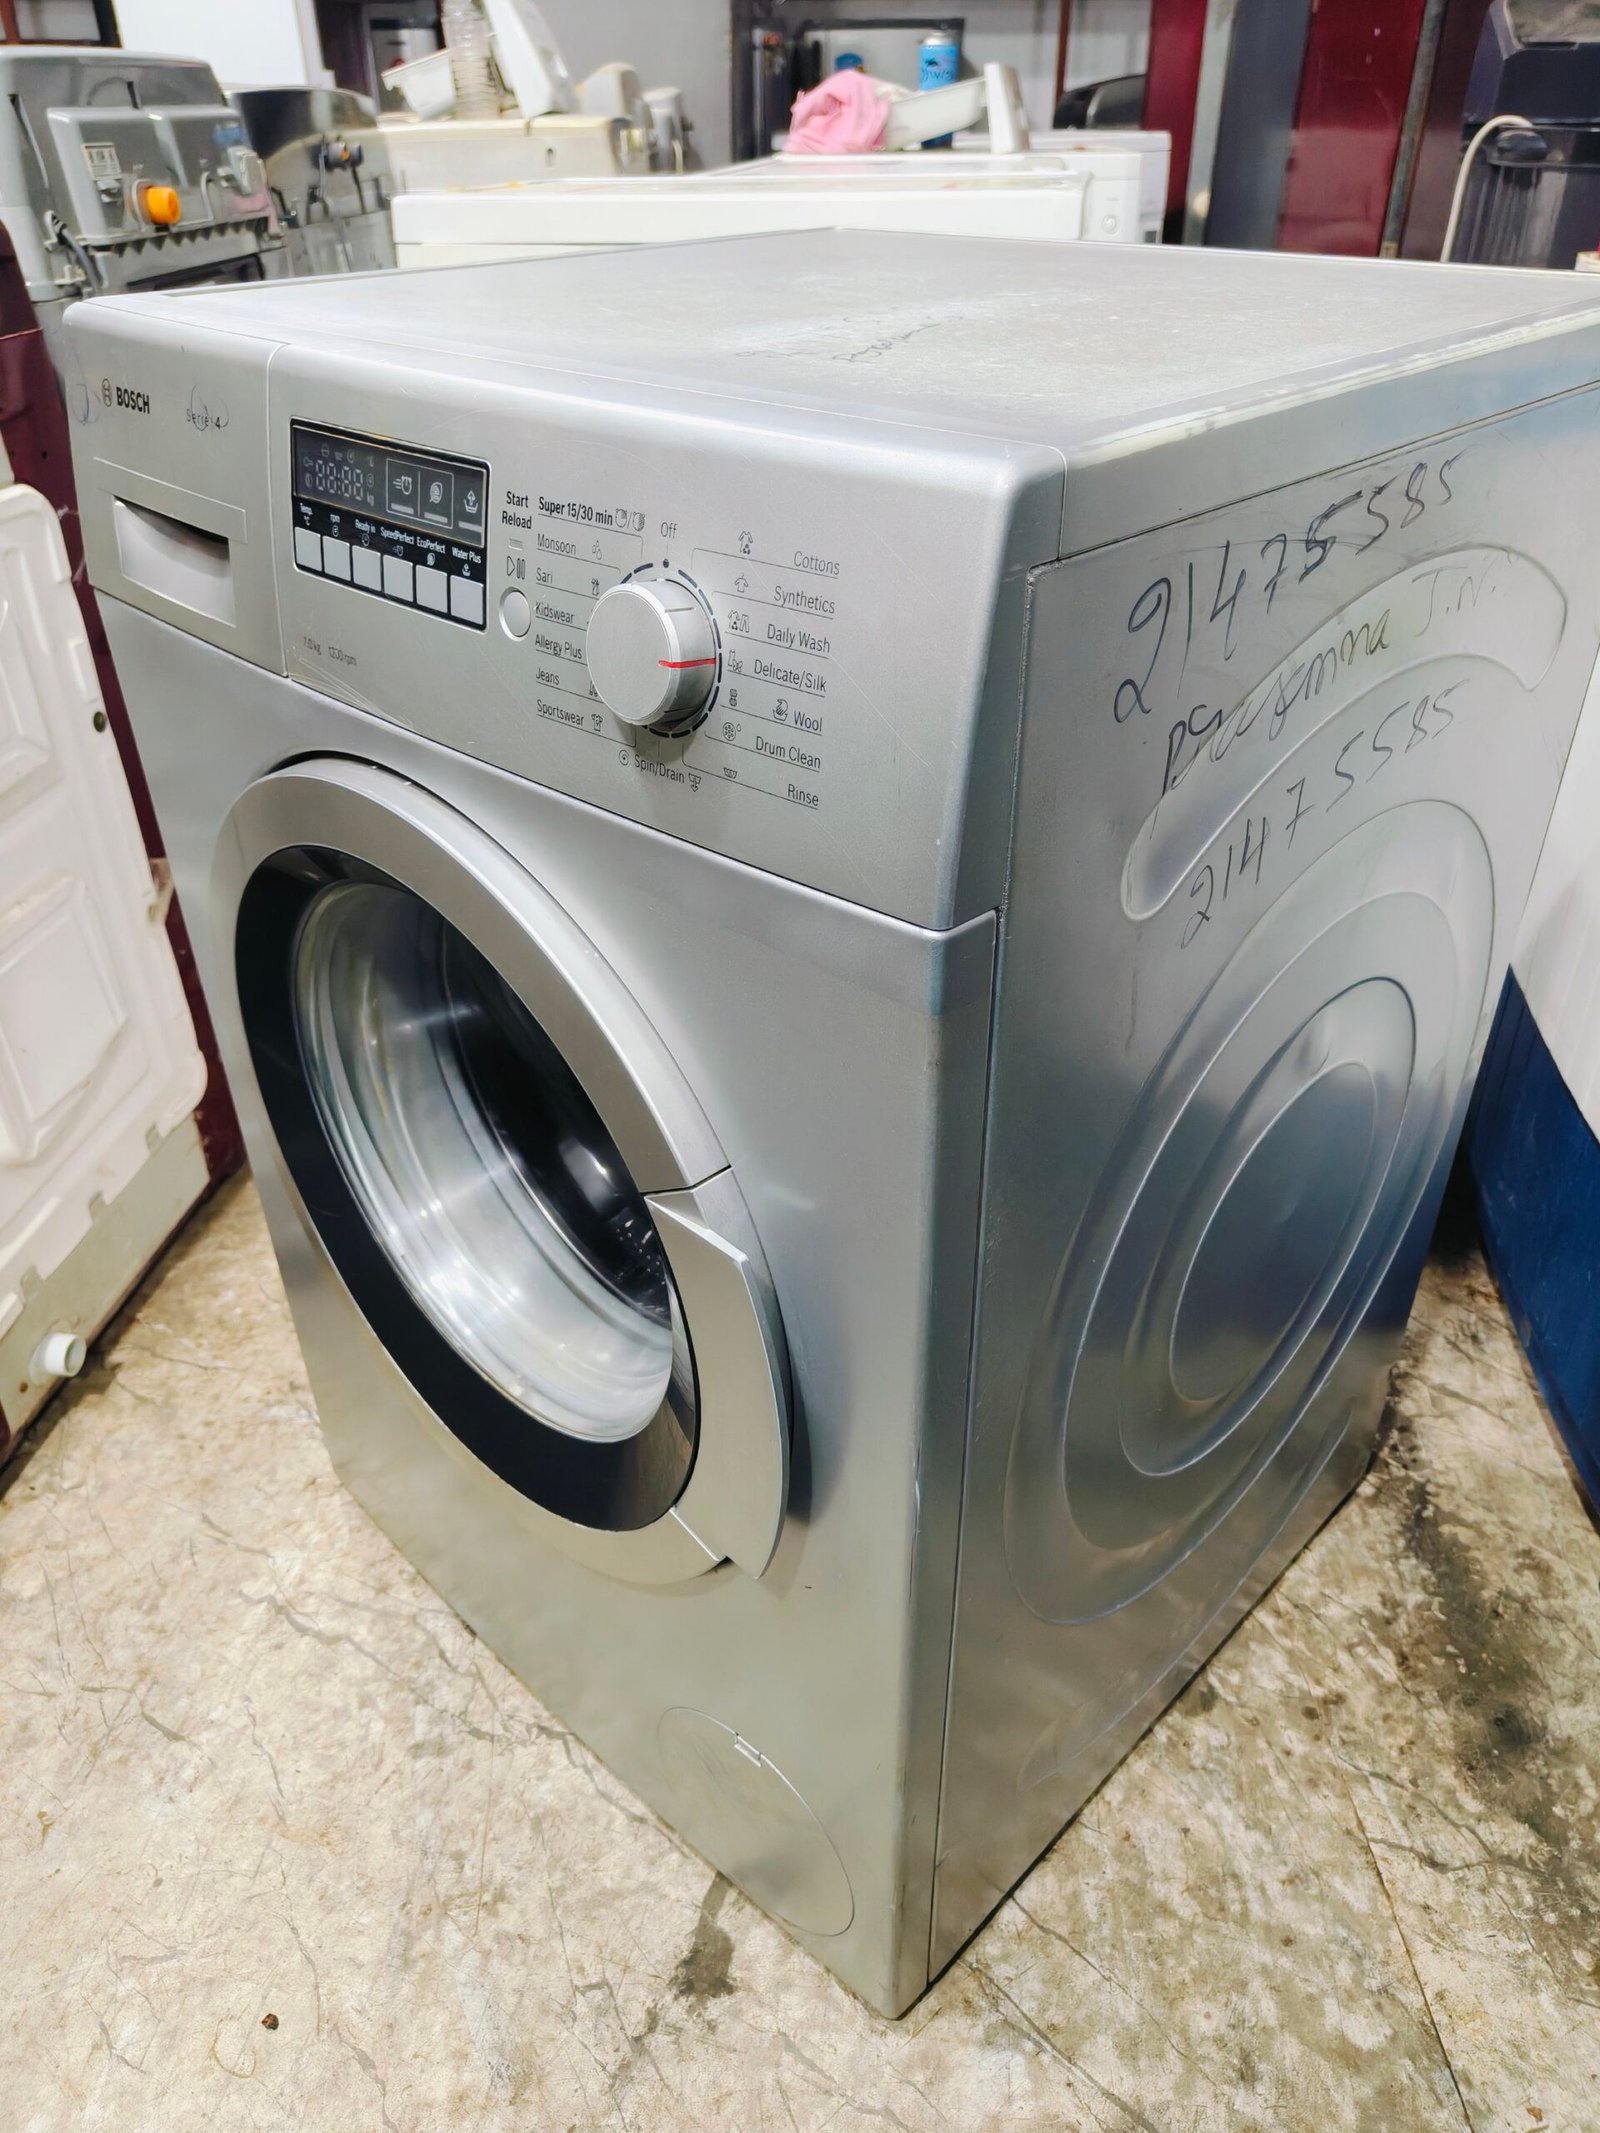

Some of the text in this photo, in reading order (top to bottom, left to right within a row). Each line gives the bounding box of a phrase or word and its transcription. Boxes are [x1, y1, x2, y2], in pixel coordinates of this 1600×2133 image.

[116, 386, 150, 414] BOSCH
[506, 490, 529, 509] Start
[538, 496, 613, 526] Super 15/30 min
[355, 519, 370, 534] Ready
[502, 510, 532, 530] Reload
[660, 521, 677, 540] Off
[380, 526, 415, 545] SpeedPerfect
[416, 536, 446, 554] EcoPerfect
[537, 533, 577, 555] Monsoon
[452, 547, 482, 564] Water Plus
[794, 551, 841, 576] Cottons
[536, 567, 553, 585] Sari
[774, 585, 836, 614] Synthetics
[535, 601, 574, 625] Kidswear
[535, 634, 583, 660] Allergy Plus
[767, 624, 831, 654] Daily Wash
[536, 668, 560, 686] Jeans
[753, 659, 827, 693] Delicate/Silk
[536, 700, 584, 726] Sportswear
[794, 710, 823, 733] Wool
[756, 736, 821, 769] Drum Clean
[634, 753, 685, 785] Spin/Drain
[787, 784, 819, 807] Rinse
